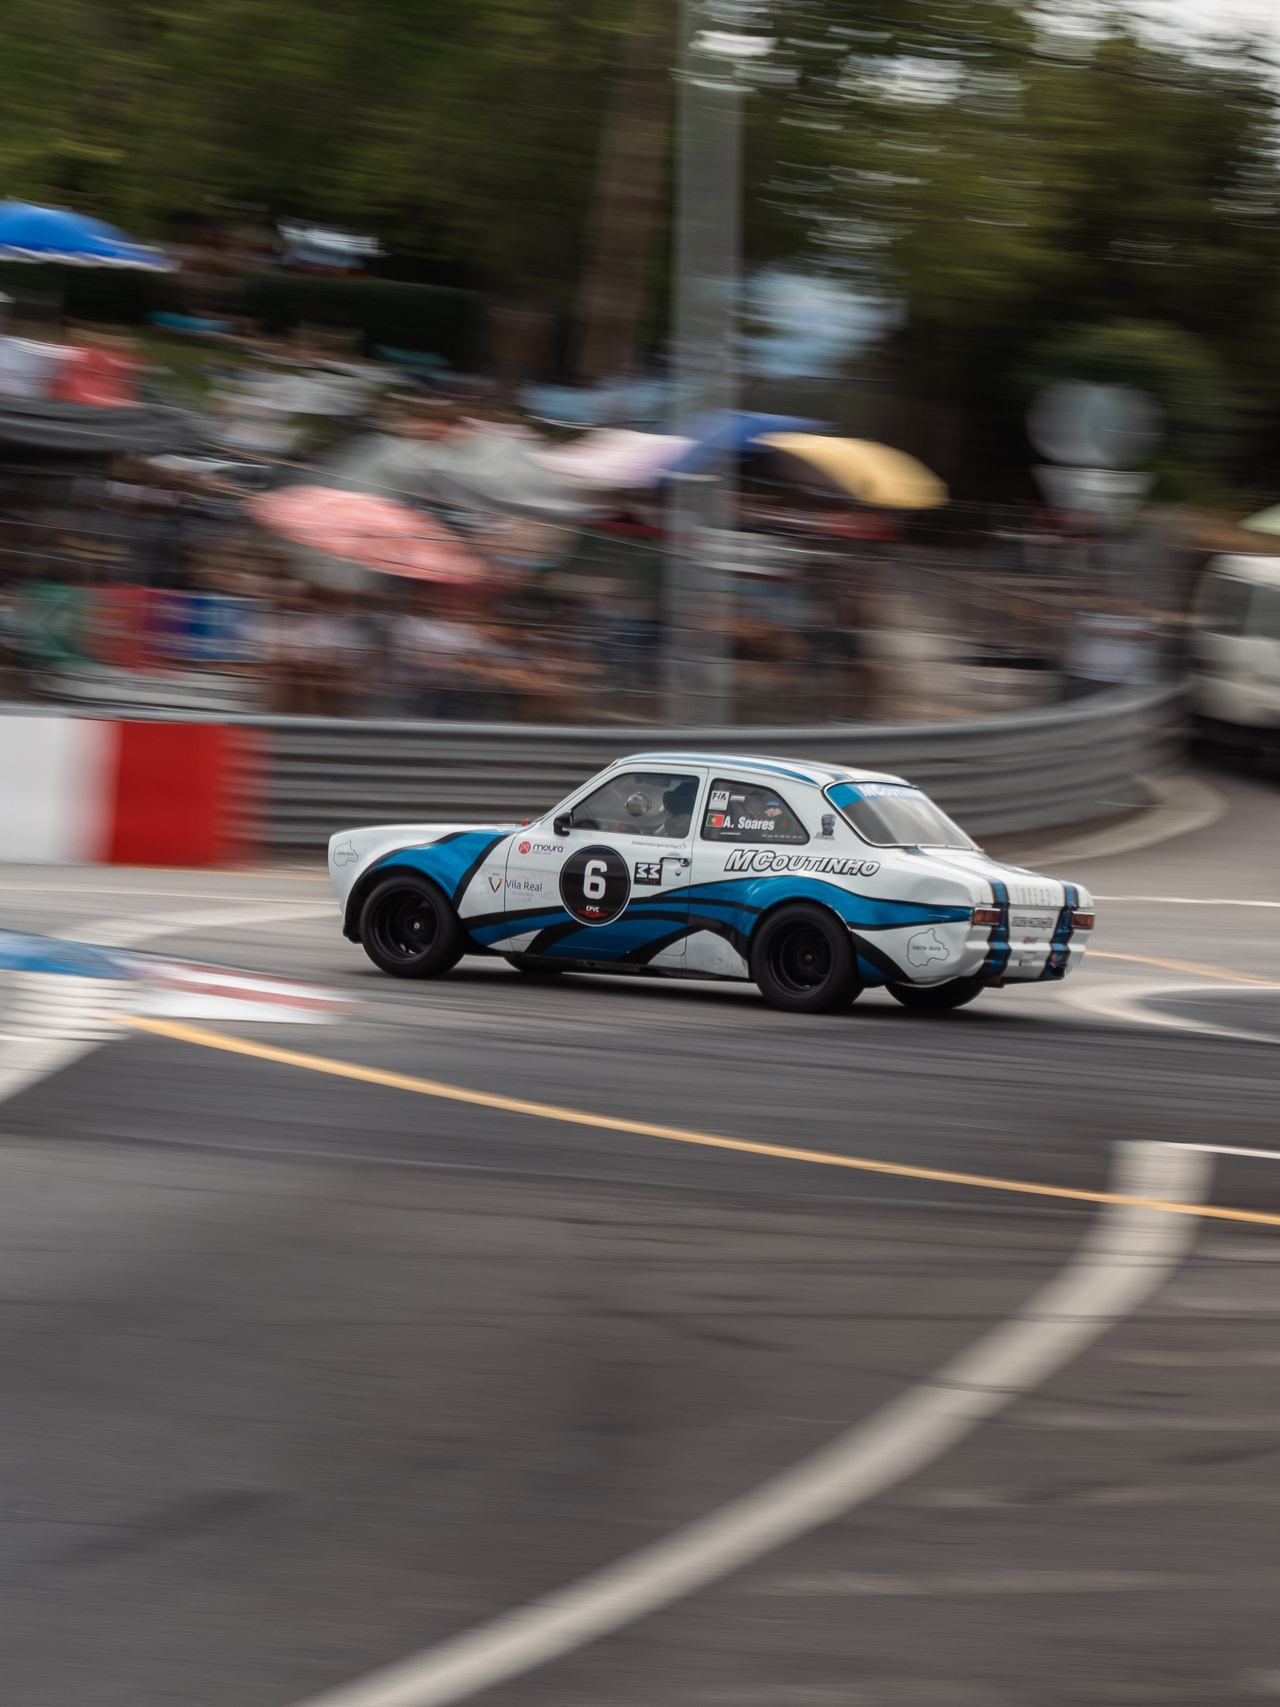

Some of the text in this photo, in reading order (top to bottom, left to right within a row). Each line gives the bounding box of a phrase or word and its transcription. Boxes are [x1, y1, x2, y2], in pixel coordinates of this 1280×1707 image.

[723, 816, 775, 831] A. Soares
[505, 879, 543, 892] Vila Real
[583, 859, 608, 900] 6
